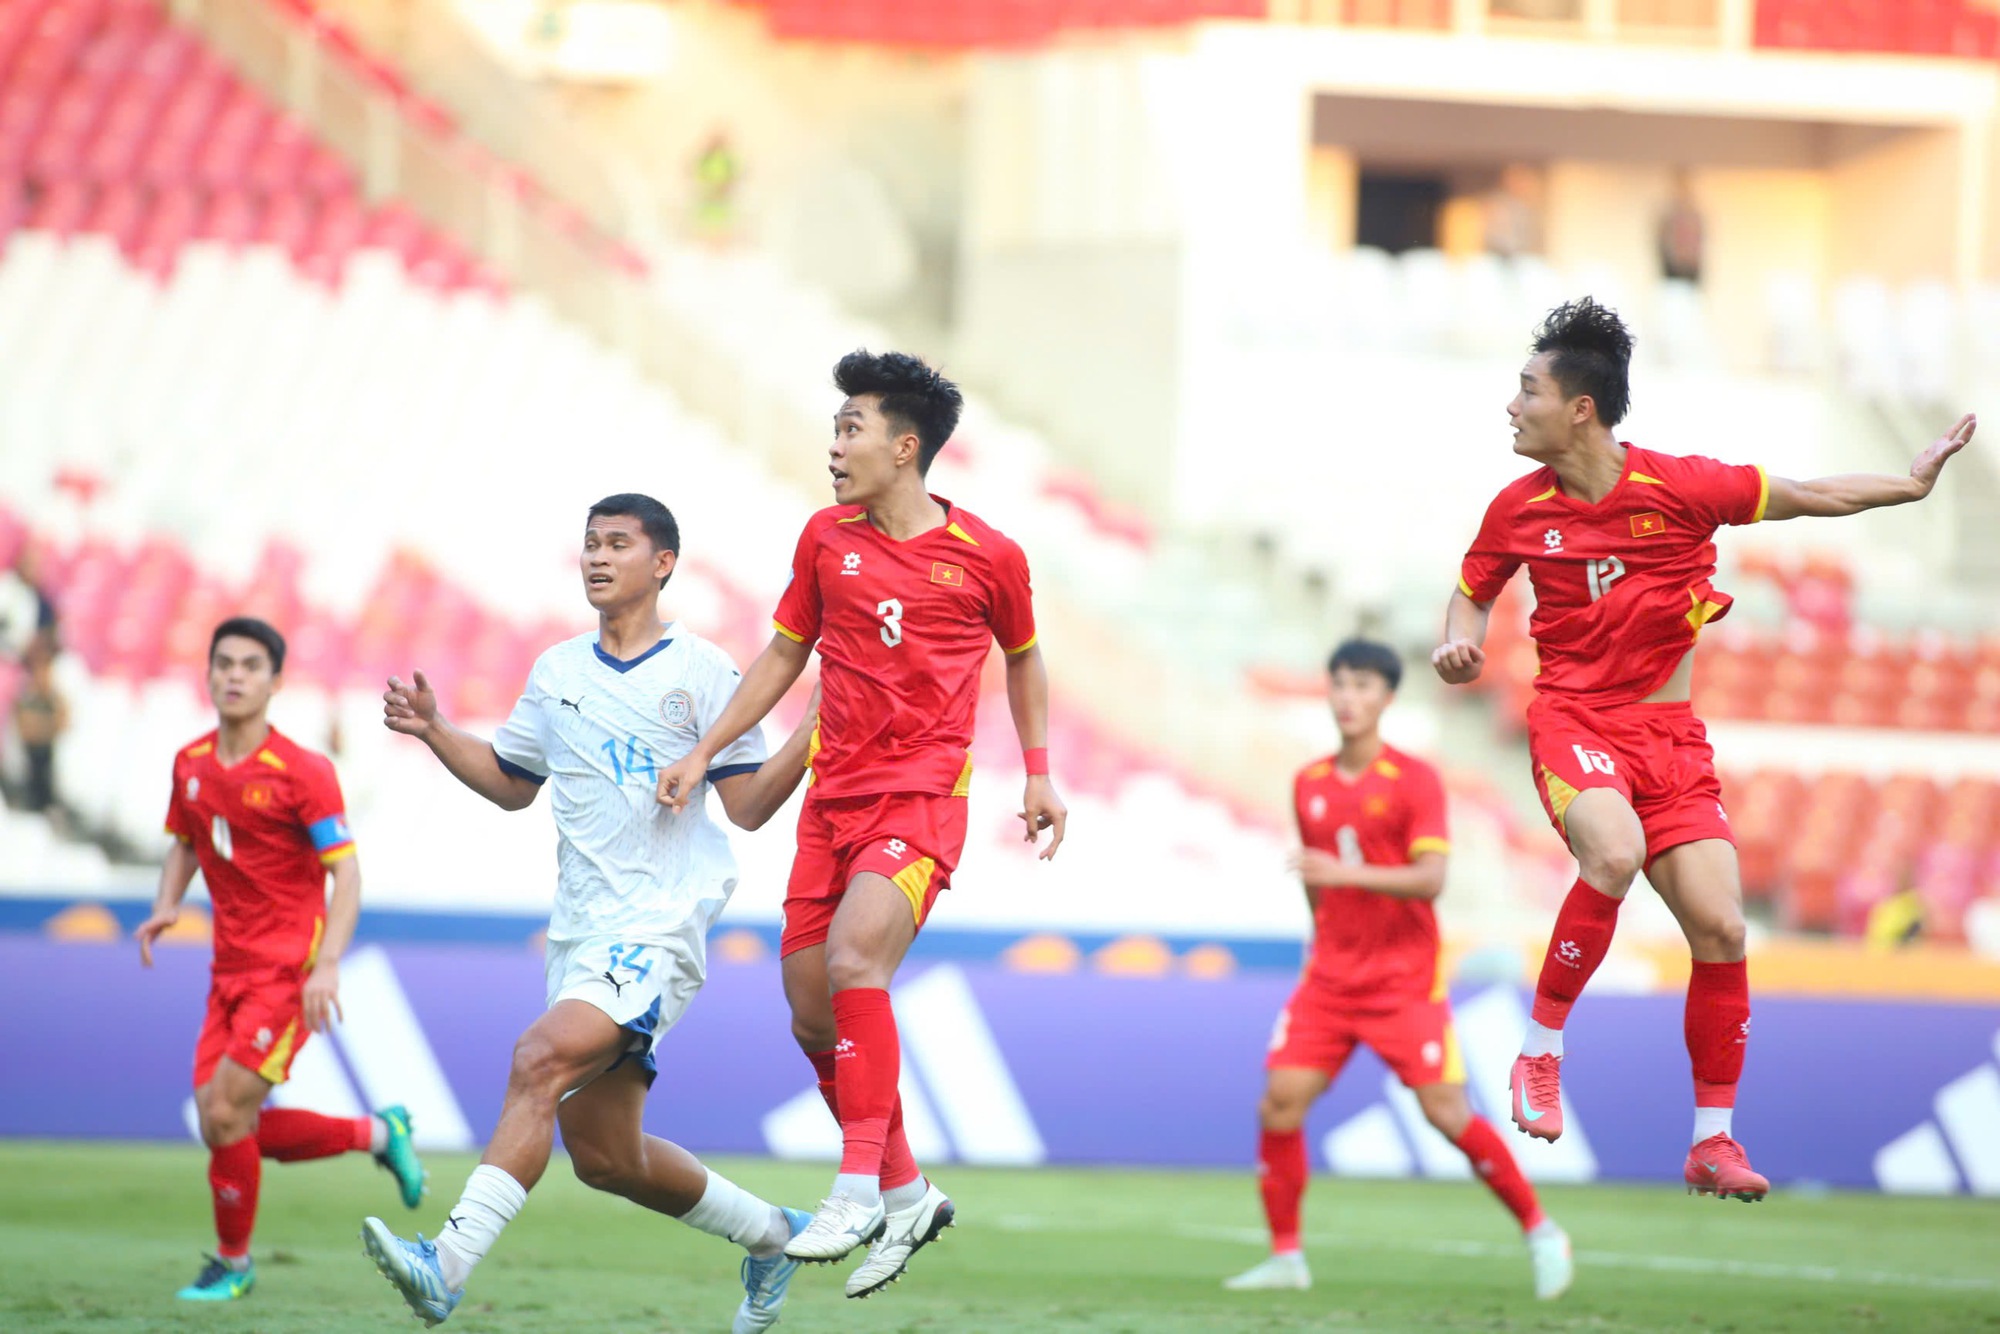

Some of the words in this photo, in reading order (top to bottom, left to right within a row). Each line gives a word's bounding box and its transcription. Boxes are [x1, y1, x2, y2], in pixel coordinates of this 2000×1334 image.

[1586, 555, 1626, 602] 12
[876, 598, 903, 648] 3
[601, 736, 657, 785] 14
[608, 943, 653, 984] 14
